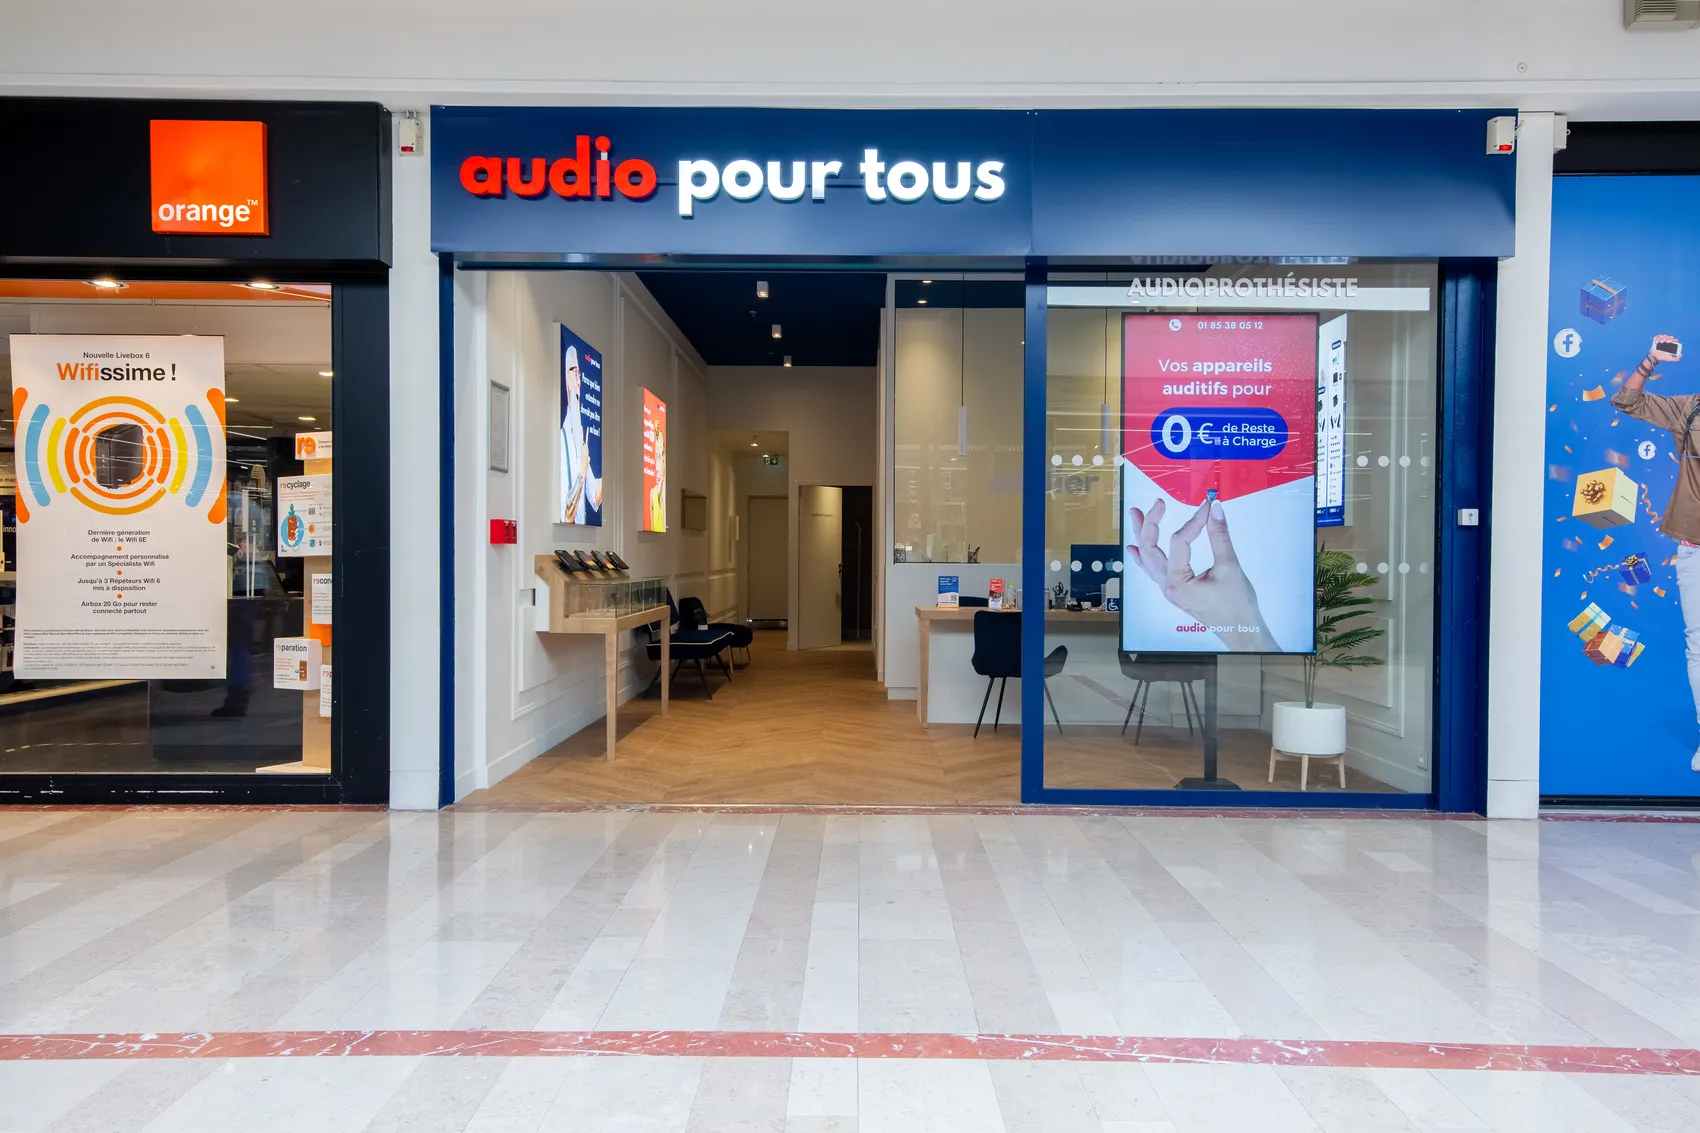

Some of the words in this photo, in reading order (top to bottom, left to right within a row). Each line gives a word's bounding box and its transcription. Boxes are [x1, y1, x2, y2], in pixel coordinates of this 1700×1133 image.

[460, 135, 657, 199] audio
[678, 158, 842, 217] pour
[860, 149, 1005, 201] tous
[1127, 271, 1358, 297] AUDIOPROTHÉSISTE
[1198, 322, 1207, 330] 01
[1210, 322, 1221, 330] 85
[1225, 322, 1236, 330] 38
[1240, 322, 1251, 330] 05
[1254, 322, 1263, 330] 12
[57, 362, 166, 381] Wifissime
[1158, 359, 1188, 372] Vos
[1193, 359, 1272, 375] appareils
[1163, 382, 1228, 395] auditifs
[1233, 385, 1271, 398] pour
[1162, 414, 1192, 452] 0
[1197, 423, 1213, 444] €
[1223, 423, 1238, 433] de
[1242, 423, 1275, 433] Reste
[1223, 436, 1229, 446] à
[1232, 436, 1276, 448] Charge
[280, 481, 310, 490] recyclage
[1176, 623, 1206, 633] audio
[1210, 625, 1234, 634] pour
[1237, 624, 1260, 633] tous
